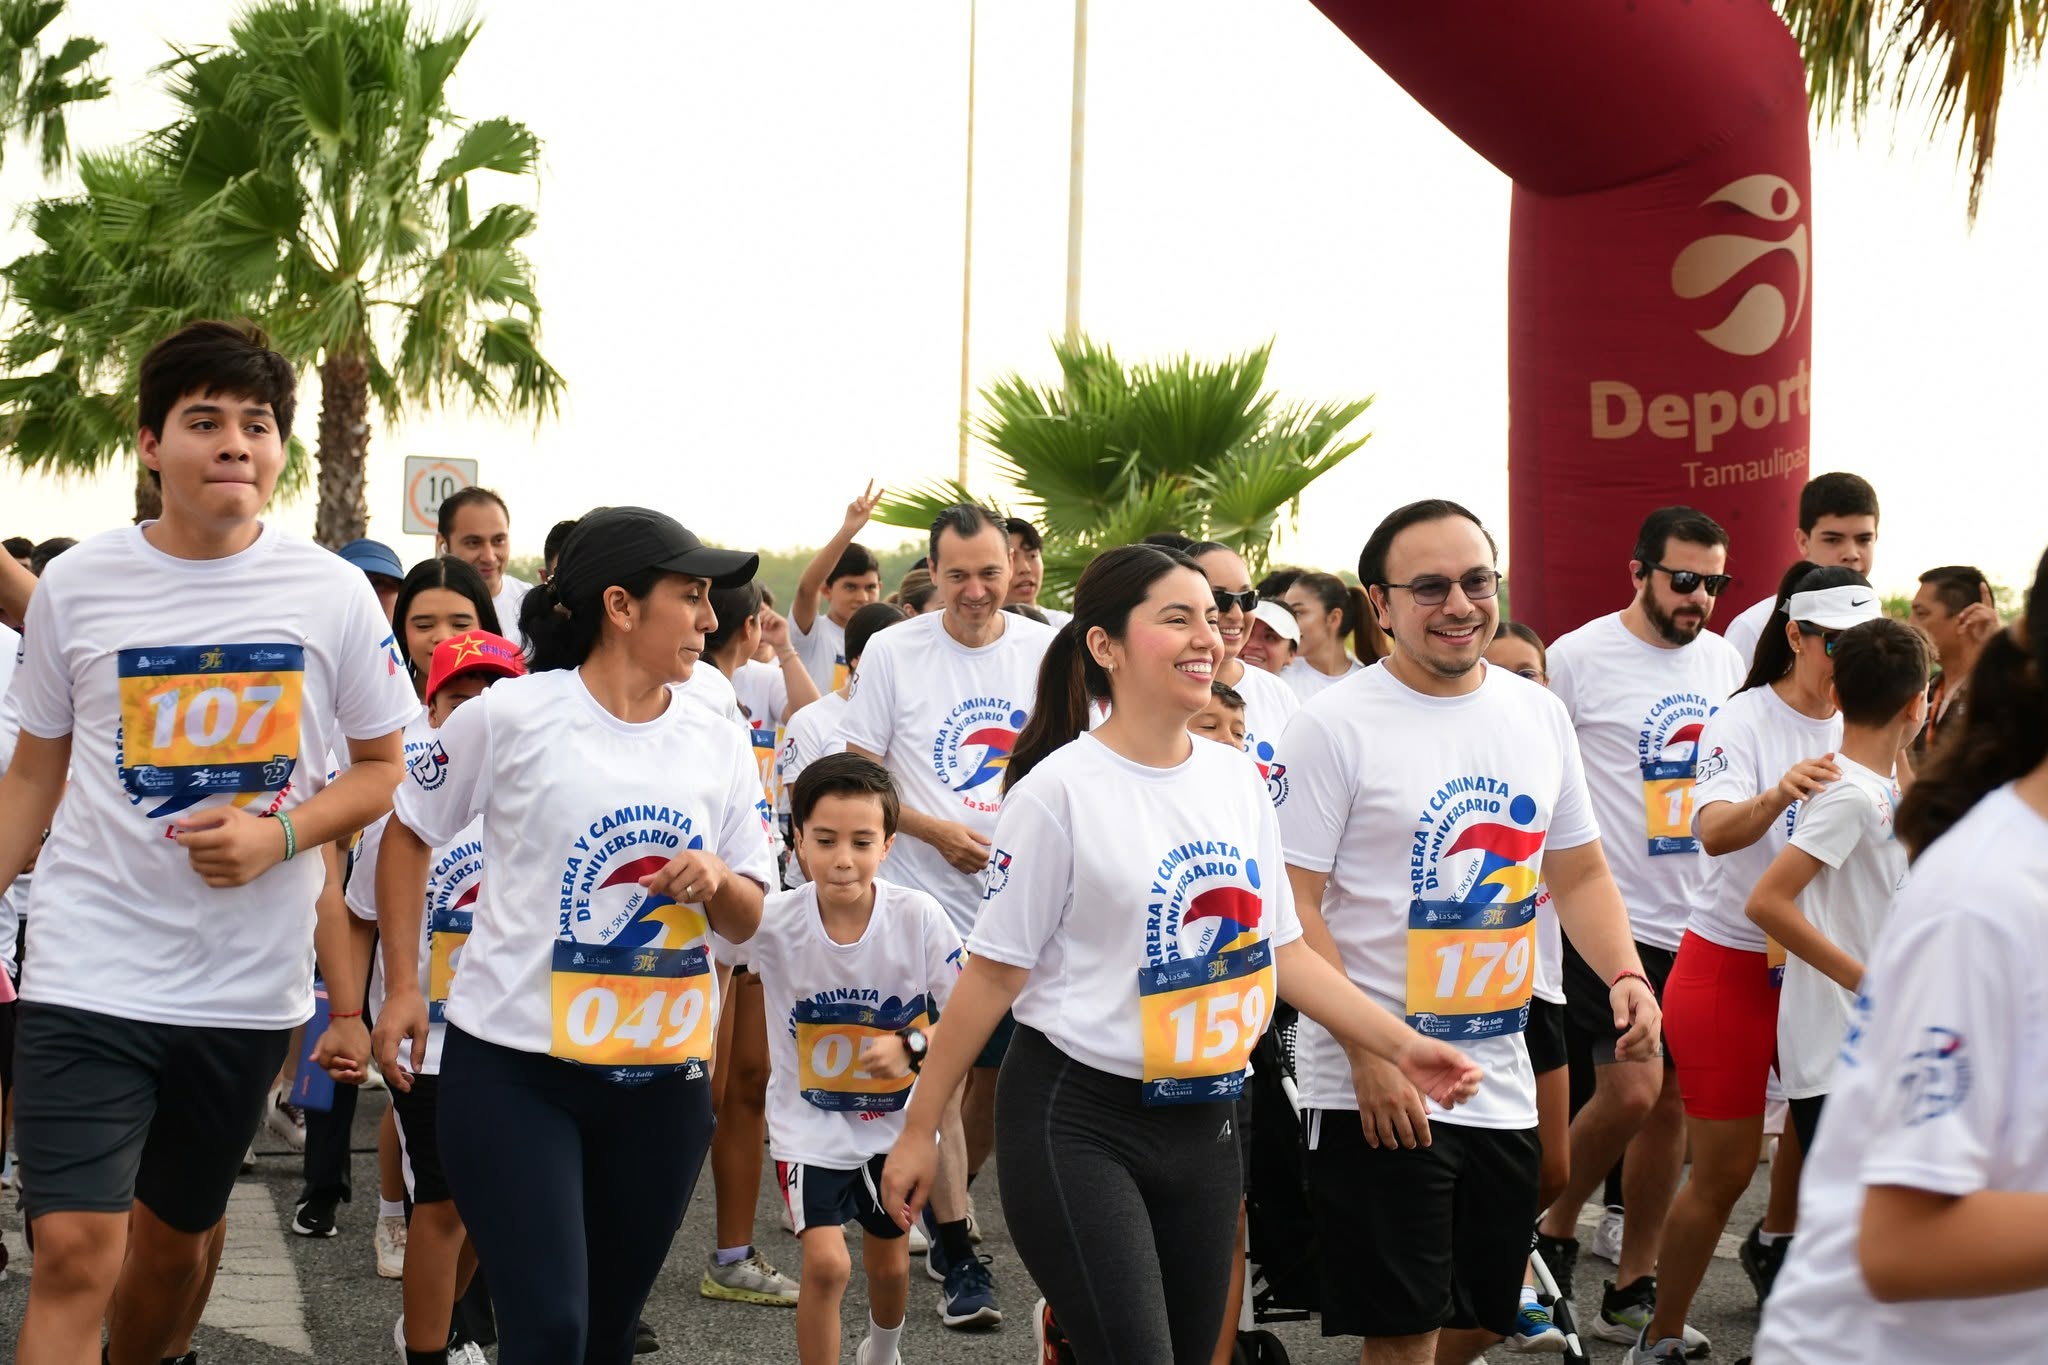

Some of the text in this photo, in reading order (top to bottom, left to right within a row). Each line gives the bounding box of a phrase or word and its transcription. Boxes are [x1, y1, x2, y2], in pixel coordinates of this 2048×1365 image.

[1590, 359, 1810, 453] Deport
[429, 476, 454, 502] 10
[1681, 446, 1807, 488] Tamaulipas
[150, 685, 284, 748] 107
[1644, 717, 1654, 726] Y
[1651, 693, 1707, 718] CAMINATA
[1656, 706, 1704, 751] ANIVERSARIO
[934, 697, 1011, 784] CARRERA Y CAMINATA
[948, 712, 1003, 768] DE ANIVERSARIO
[963, 797, 975, 808] La
[574, 836, 590, 852] Y
[589, 804, 692, 839] CAMINATA
[1411, 776, 1509, 896] RRERA Y CAMINATA
[1426, 798, 1500, 890] DE ANIVERSARIO
[435, 841, 482, 876] CAMIN
[576, 829, 679, 922] DE ANIVERSARIO
[611, 914, 625, 931] 5K
[626, 892, 643, 911] 10K
[1146, 840, 1241, 968] RRERA Y CAMINATA
[1166, 862, 1237, 936] ANIVERSARIO
[586, 955, 611, 964] La Salle
[1201, 926, 1215, 947] 10K
[1176, 971, 1191, 980] Salle
[1435, 936, 1530, 998] 179
[566, 986, 704, 1048] 049
[806, 988, 879, 1005] MINATA
[1169, 985, 1265, 1064] 159
[1490, 1017, 1504, 1026] Salle
[685, 1070, 704, 1081] adidas
